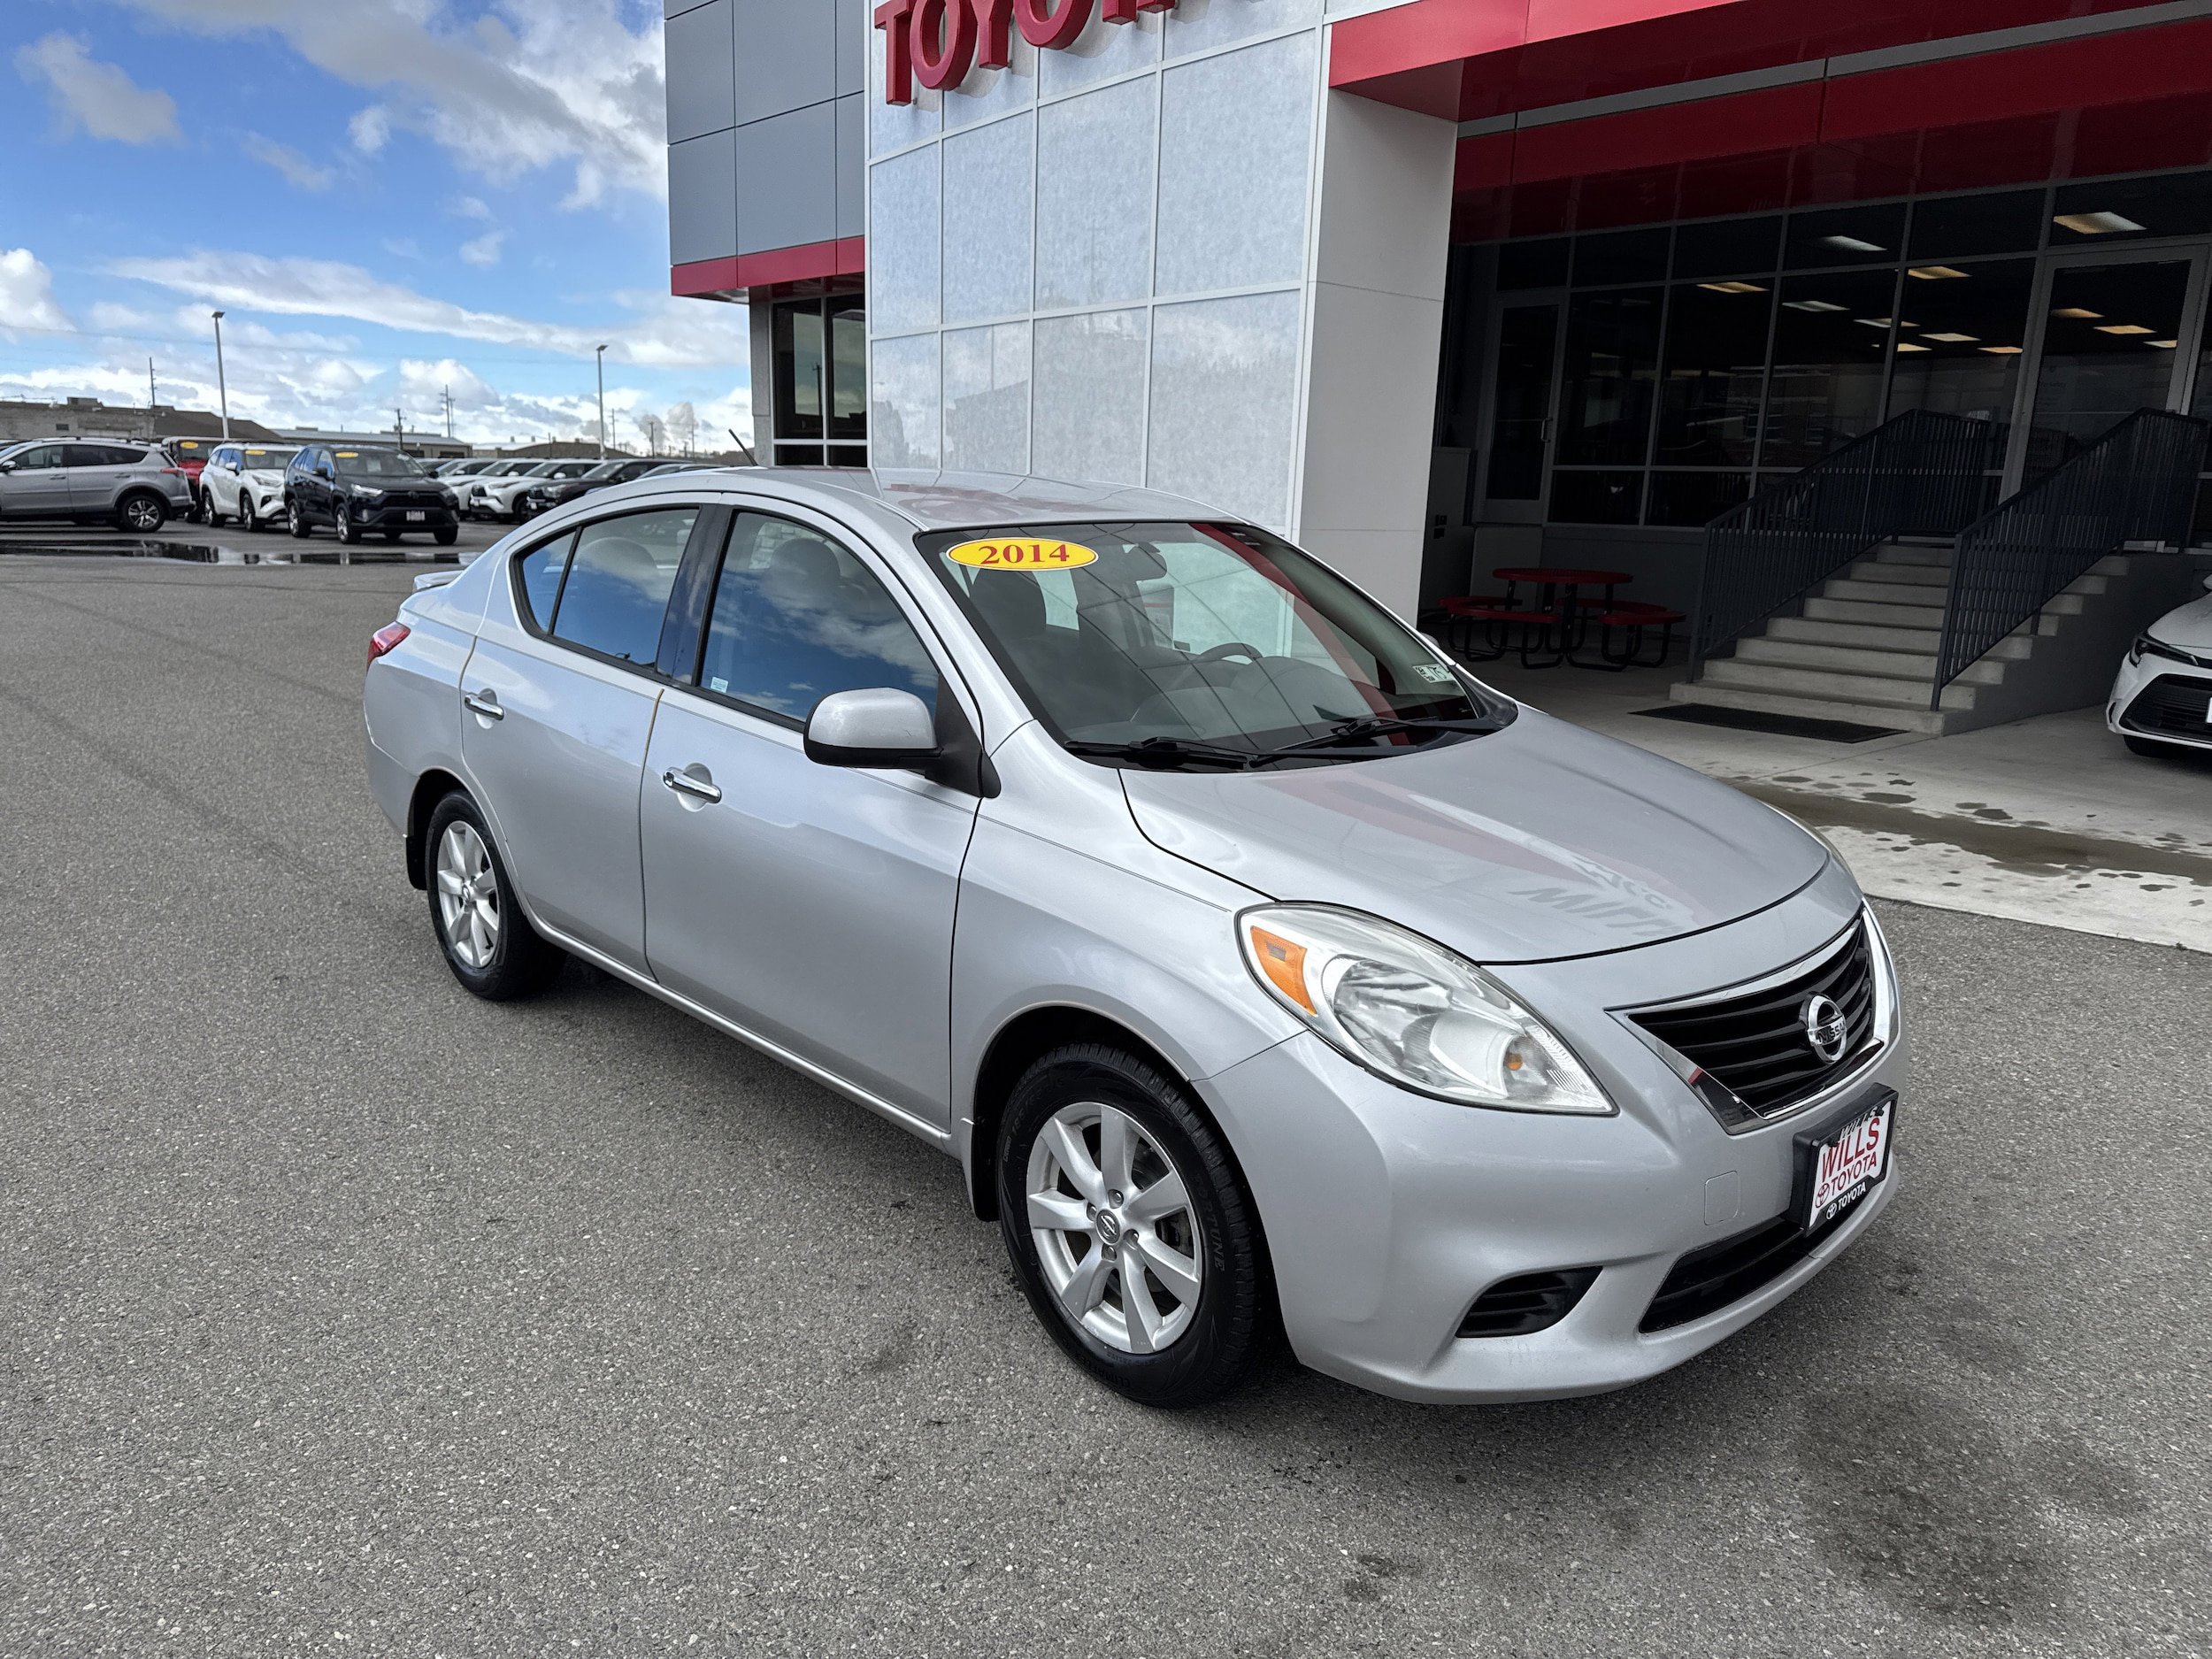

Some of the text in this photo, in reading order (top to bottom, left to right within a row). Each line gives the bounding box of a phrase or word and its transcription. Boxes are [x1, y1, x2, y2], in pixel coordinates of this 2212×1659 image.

[978, 543, 1070, 565] 2014
[1822, 1117, 1880, 1183] WILLS
[1831, 1151, 1877, 1196] TOYOTA
[1837, 1181, 1866, 1211] TOYOTA
